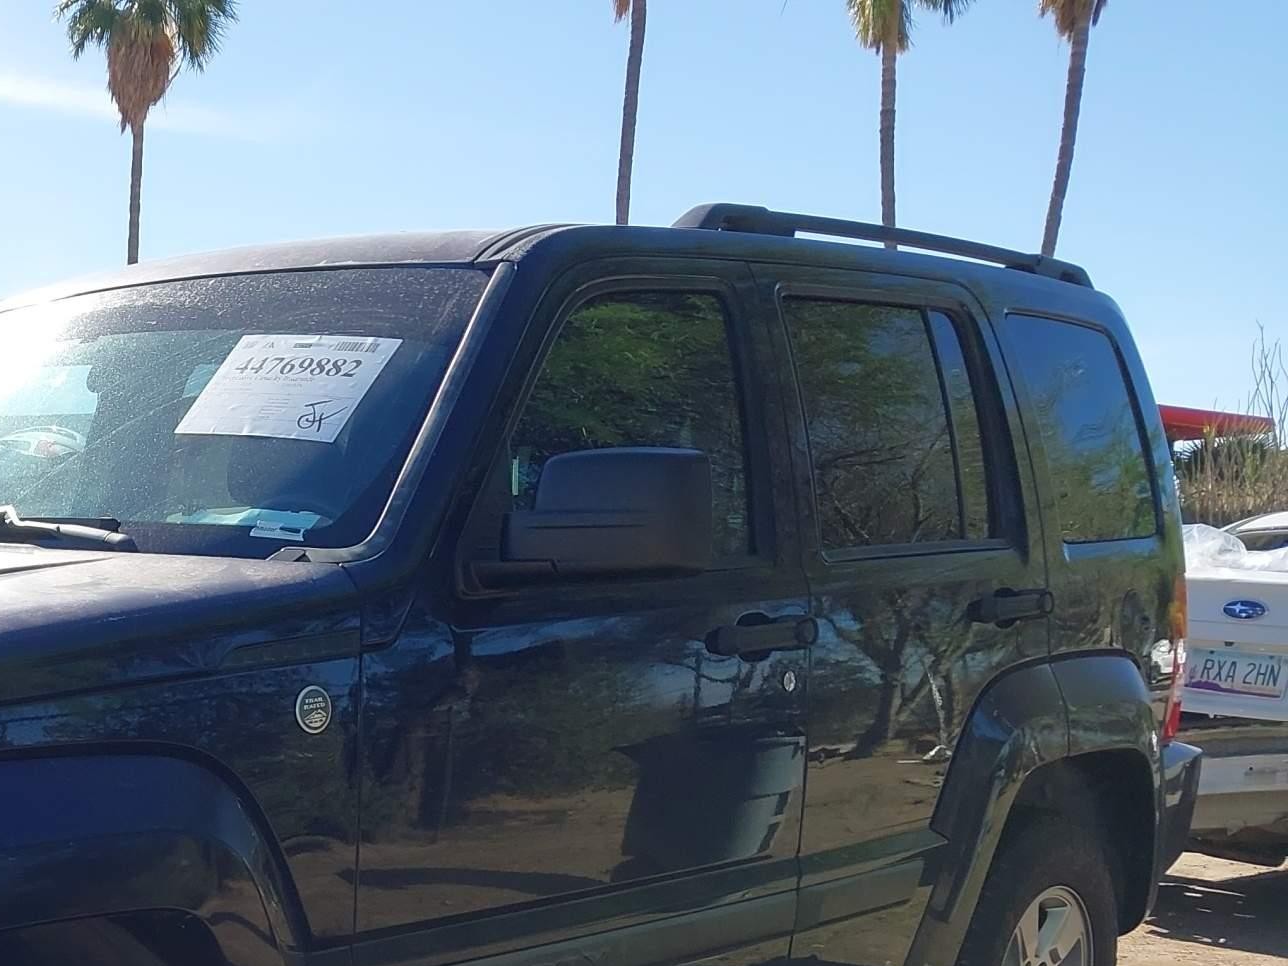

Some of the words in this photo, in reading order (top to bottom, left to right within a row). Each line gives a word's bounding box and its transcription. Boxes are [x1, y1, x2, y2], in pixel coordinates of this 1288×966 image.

[234, 356, 363, 378] 44769882
[1200, 658, 1237, 683] RXA
[1242, 662, 1281, 687] 2HN
[303, 702, 326, 711] RATED
